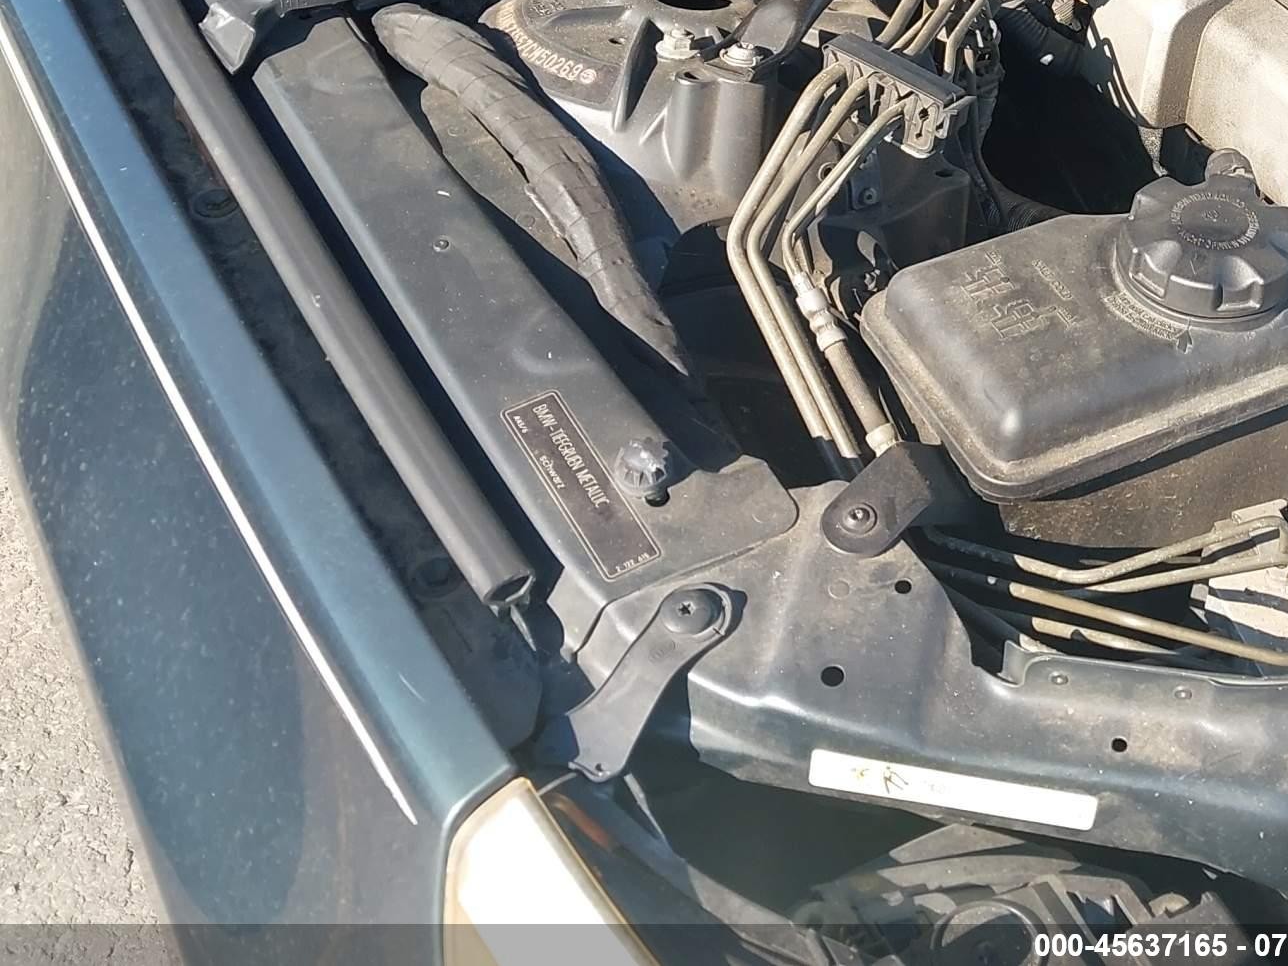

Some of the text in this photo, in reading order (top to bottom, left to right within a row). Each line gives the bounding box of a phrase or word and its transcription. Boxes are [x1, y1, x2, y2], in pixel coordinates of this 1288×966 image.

[532, 403, 610, 509] BMW-TIEFGRUEN METALLIC
[539, 454, 568, 490] schwarz
